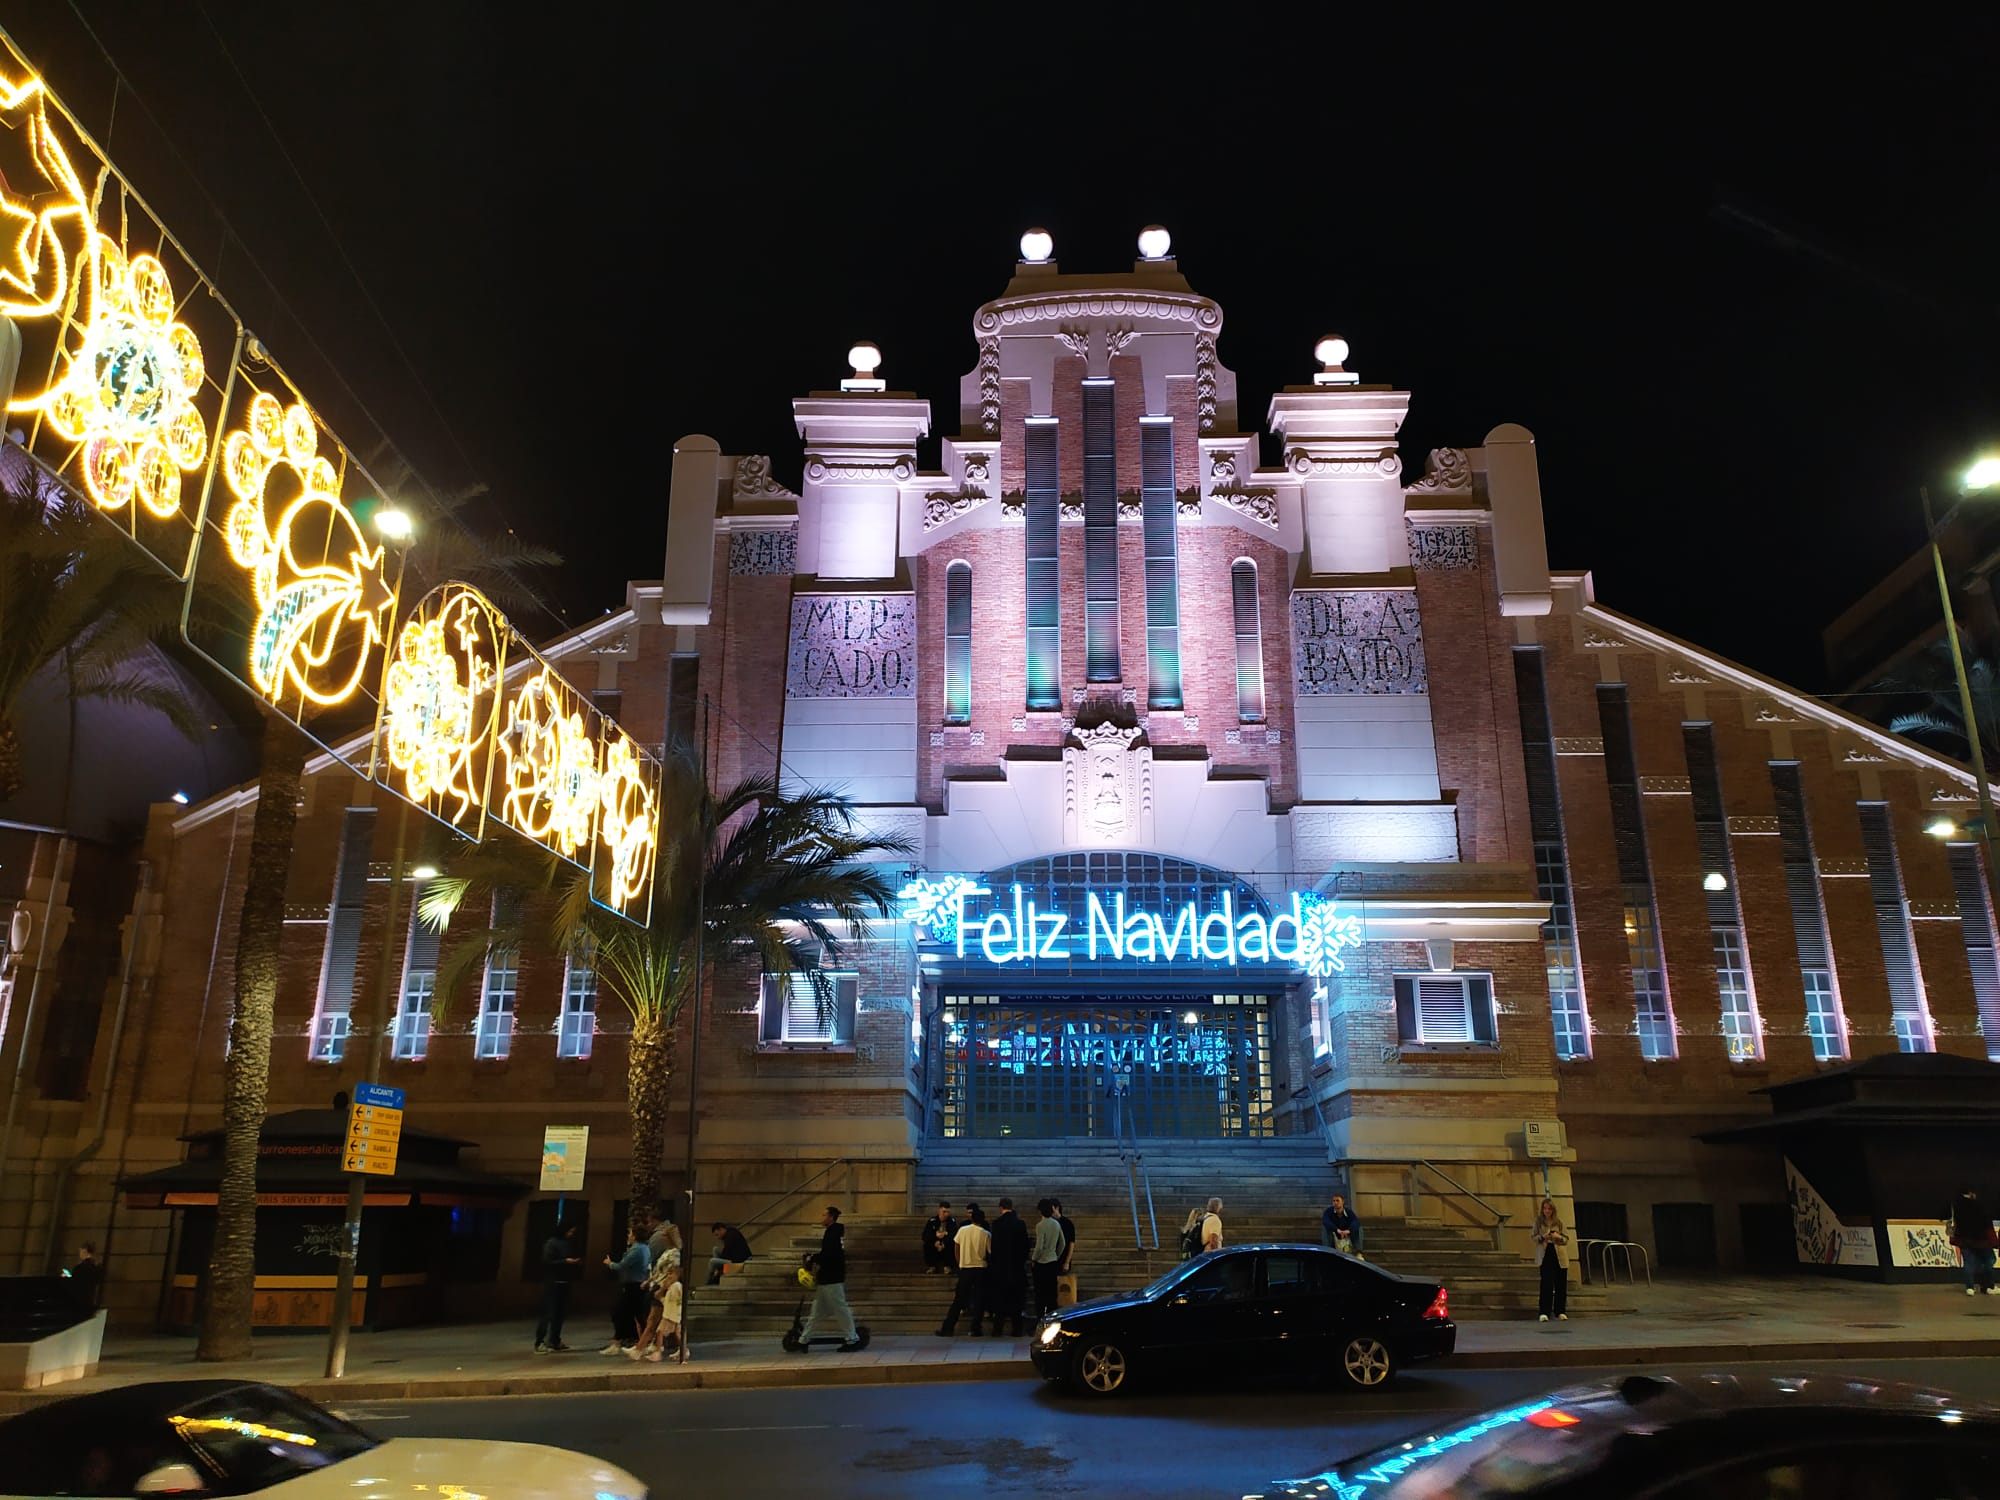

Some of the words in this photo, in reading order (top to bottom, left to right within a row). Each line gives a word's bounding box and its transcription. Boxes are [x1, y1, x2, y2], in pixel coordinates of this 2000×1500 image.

[799, 600, 905, 640] MER-
[1305, 596, 1358, 637] DE
[804, 647, 902, 690] CADO
[1303, 639, 1416, 682] BASTOS
[954, 884, 1070, 963] Feliz
[1088, 889, 1308, 965] Navidad
